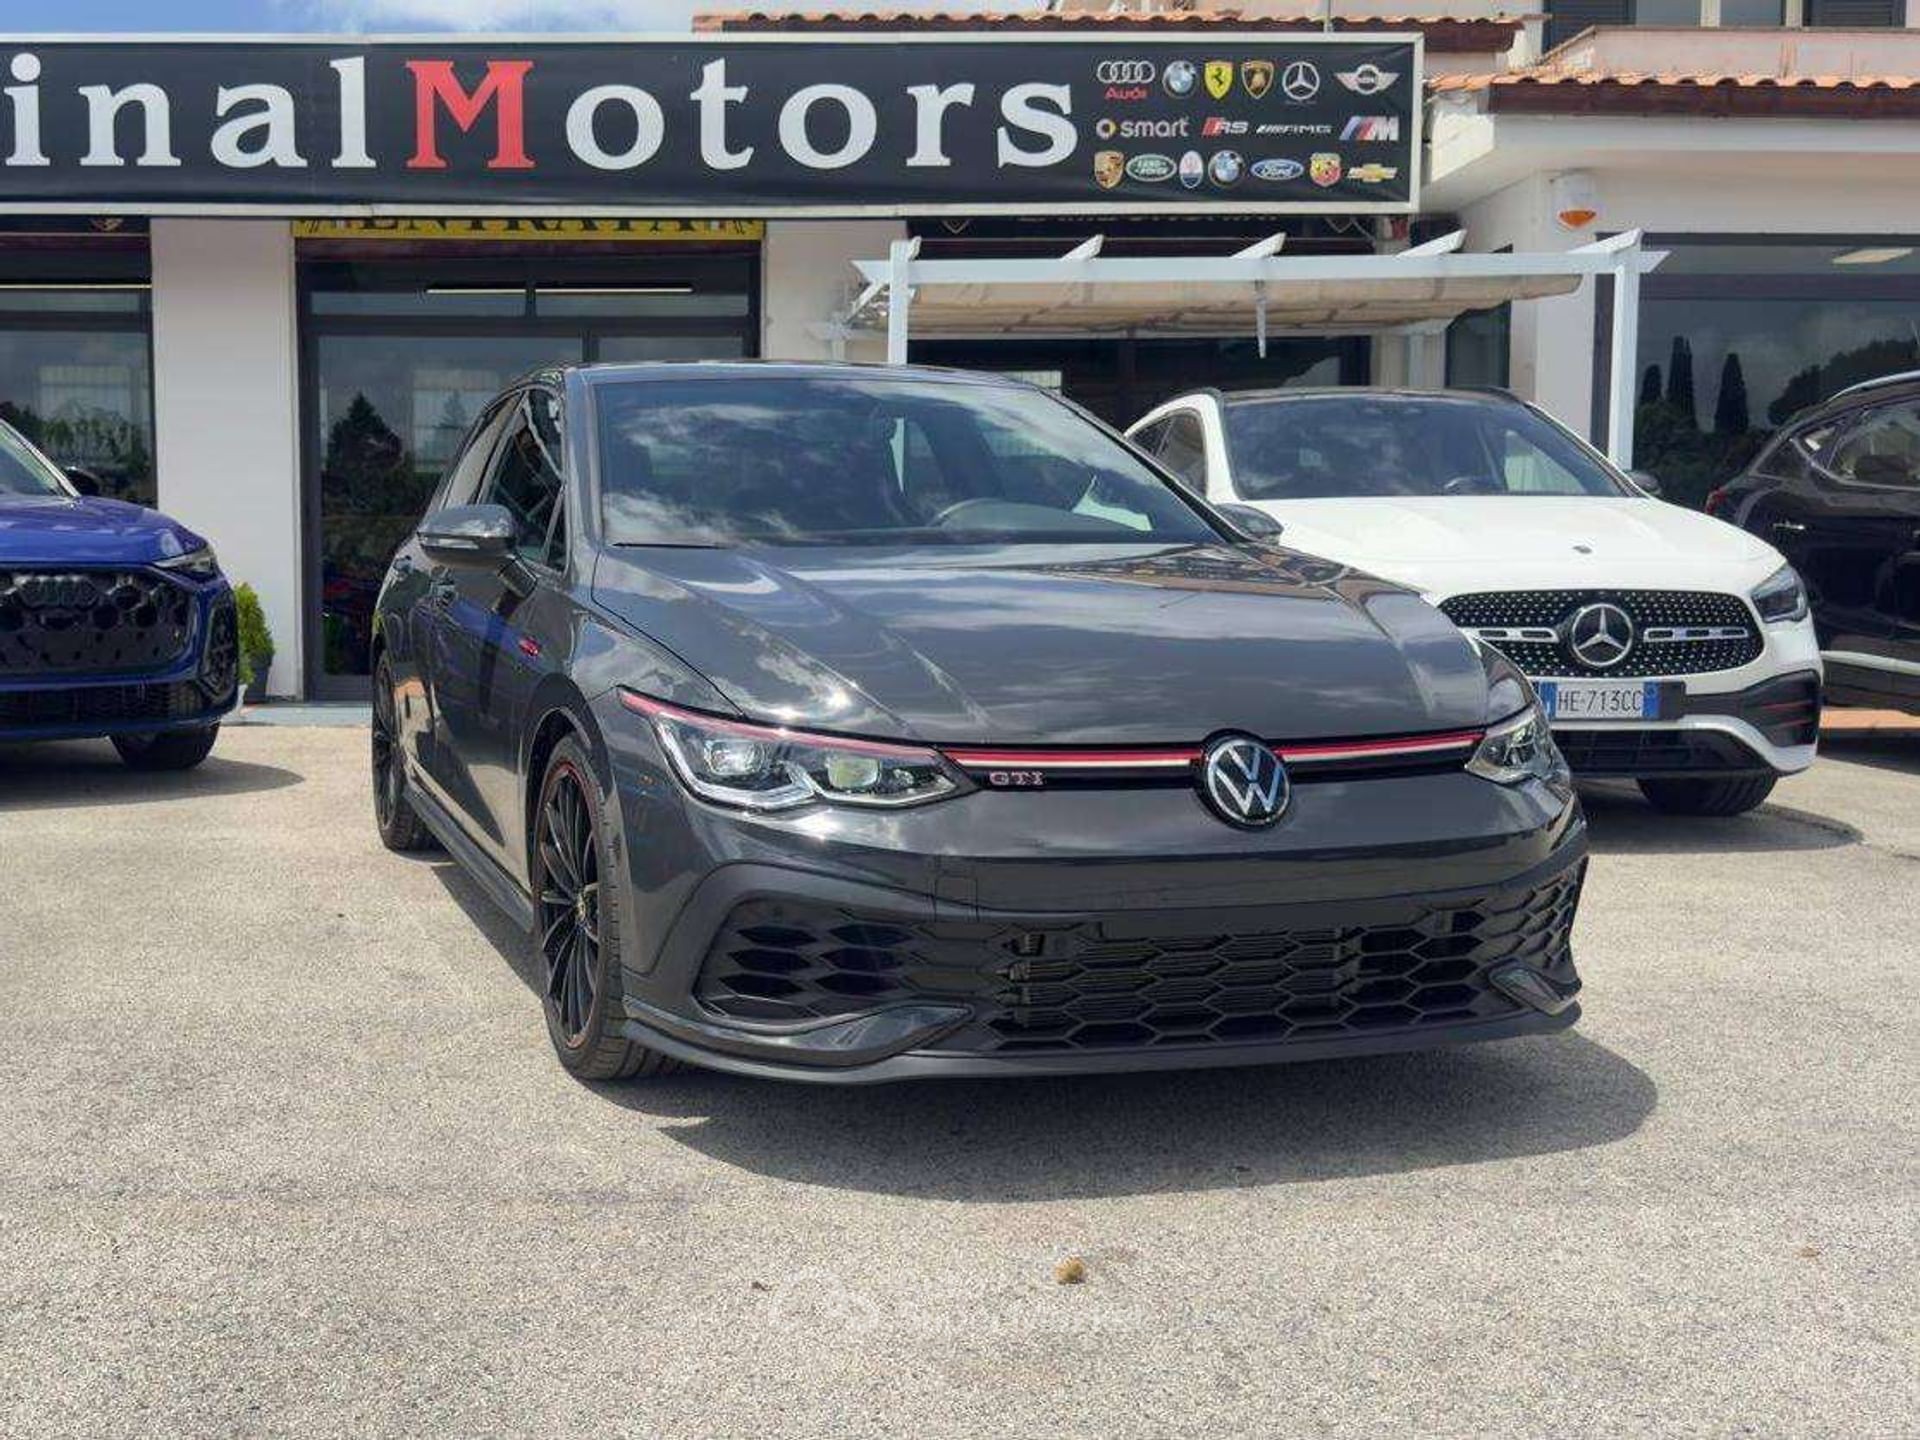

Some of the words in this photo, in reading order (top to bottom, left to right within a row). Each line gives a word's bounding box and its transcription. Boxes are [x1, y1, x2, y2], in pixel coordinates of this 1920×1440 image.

[1104, 87, 1147, 99] Audi
[1120, 118, 1190, 138] smart
[1558, 690, 1582, 712] HE
[1586, 690, 1643, 712] 713CC
[989, 771, 1045, 787] GTI
